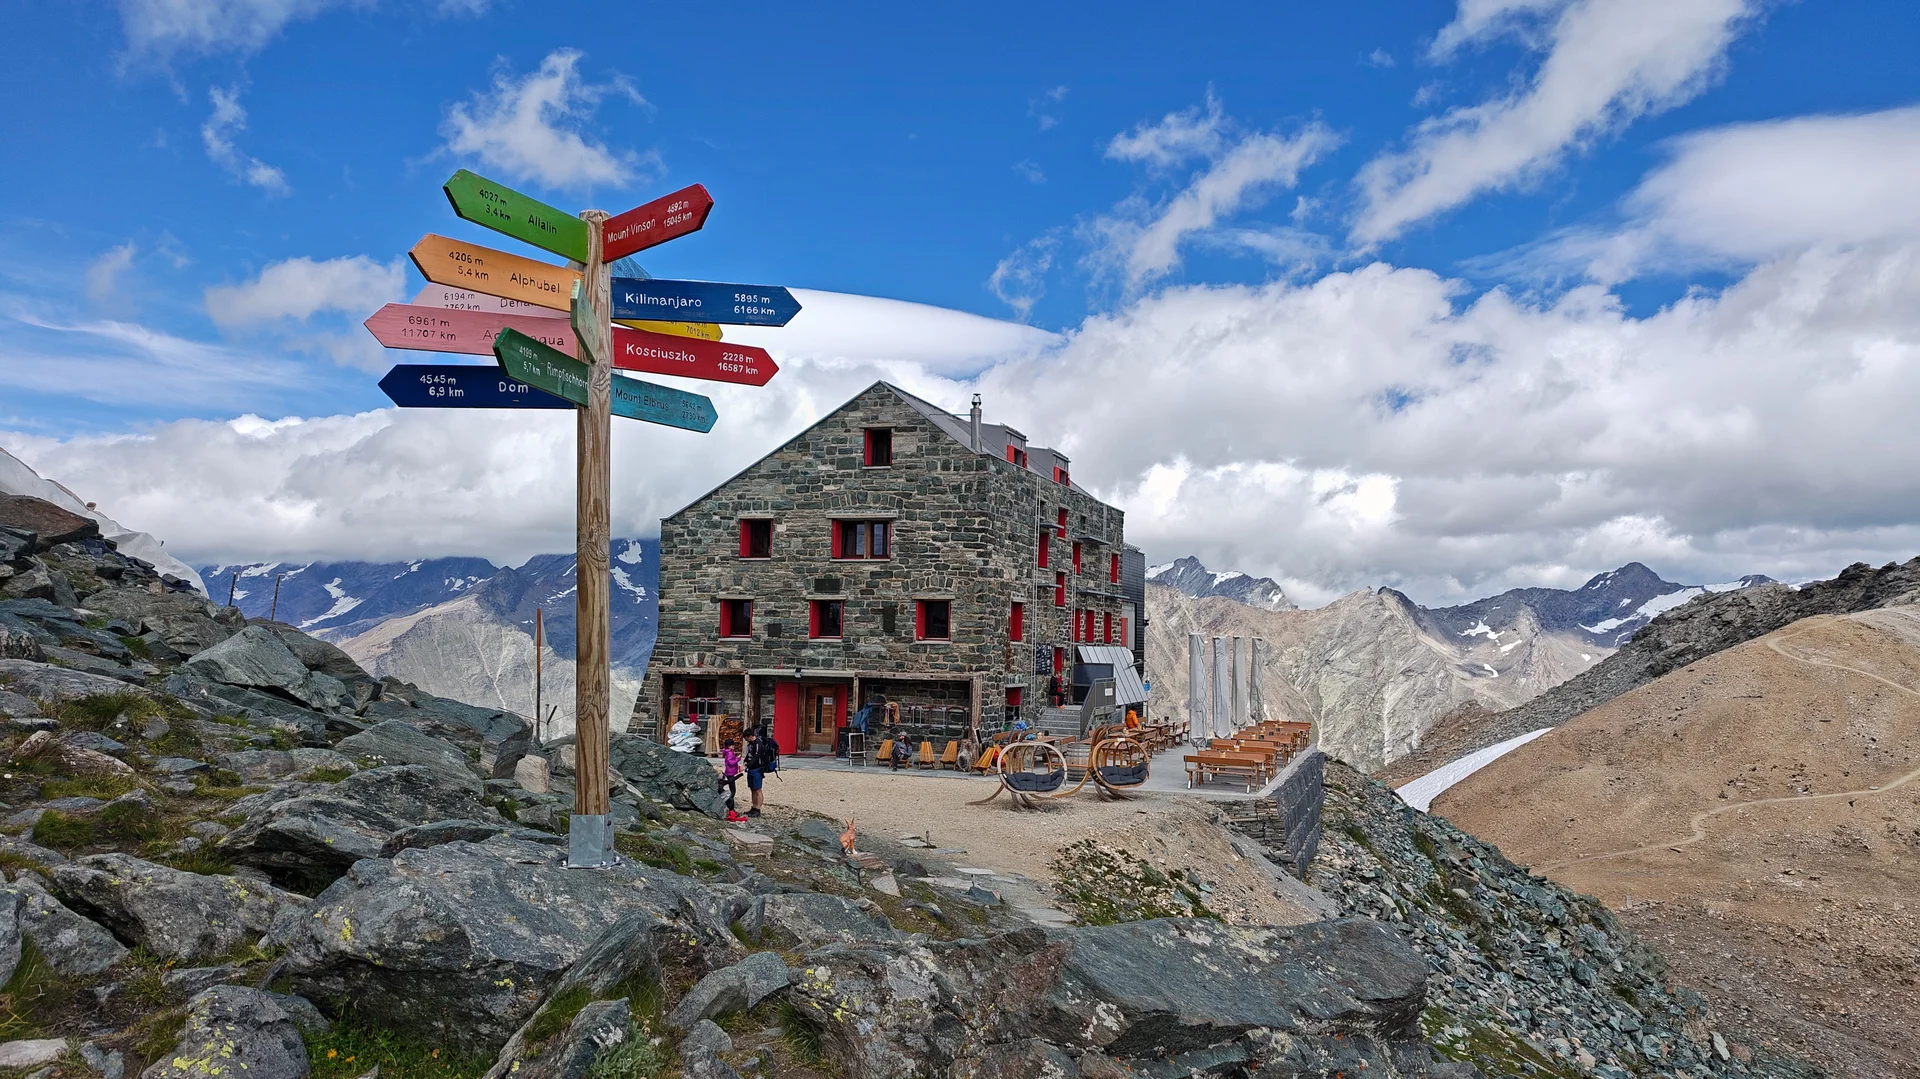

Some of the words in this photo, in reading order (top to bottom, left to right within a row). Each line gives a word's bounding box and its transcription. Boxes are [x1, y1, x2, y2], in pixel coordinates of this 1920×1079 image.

[479, 188, 499, 203] 4027
[500, 198, 507, 206] m
[486, 204, 498, 217] 3,4
[499, 210, 512, 222] km
[667, 201, 682, 214] 4892
[682, 200, 689, 209] m
[528, 214, 558, 234] Allalin
[663, 214, 682, 228] 15045
[682, 210, 693, 222] km
[607, 225, 629, 243] Mount
[630, 218, 656, 236] Vinson
[448, 252, 472, 264] 4206
[475, 258, 484, 266] m
[458, 266, 472, 278] 5,4
[475, 270, 489, 280] km
[510, 273, 560, 294] Alphubel
[444, 292, 465, 300] 6194
[625, 292, 702, 308] Kilimanjaro
[734, 293, 759, 302] 5895
[761, 295, 771, 304] m
[734, 305, 759, 315] 6166
[760, 306, 776, 316] km
[408, 316, 436, 326] 6961
[440, 319, 450, 327] m
[402, 328, 435, 338] 11707
[440, 330, 456, 340] km
[686, 326, 700, 336] 7012
[518, 346, 532, 358] 4199
[626, 344, 696, 363] Kosciuszko
[722, 352, 744, 362] 2228
[745, 356, 754, 364] m
[523, 360, 532, 372] 5,7
[532, 366, 540, 376] km
[718, 362, 744, 374] 16587
[746, 366, 758, 375] km
[420, 374, 447, 384] 4545
[448, 377, 456, 385] m
[546, 362, 588, 390] Rimpfischhorn
[429, 386, 446, 398] 6,9
[449, 386, 464, 398] km
[498, 382, 528, 394] Dom
[615, 388, 641, 404] Mount
[644, 396, 670, 411] Elbrus
